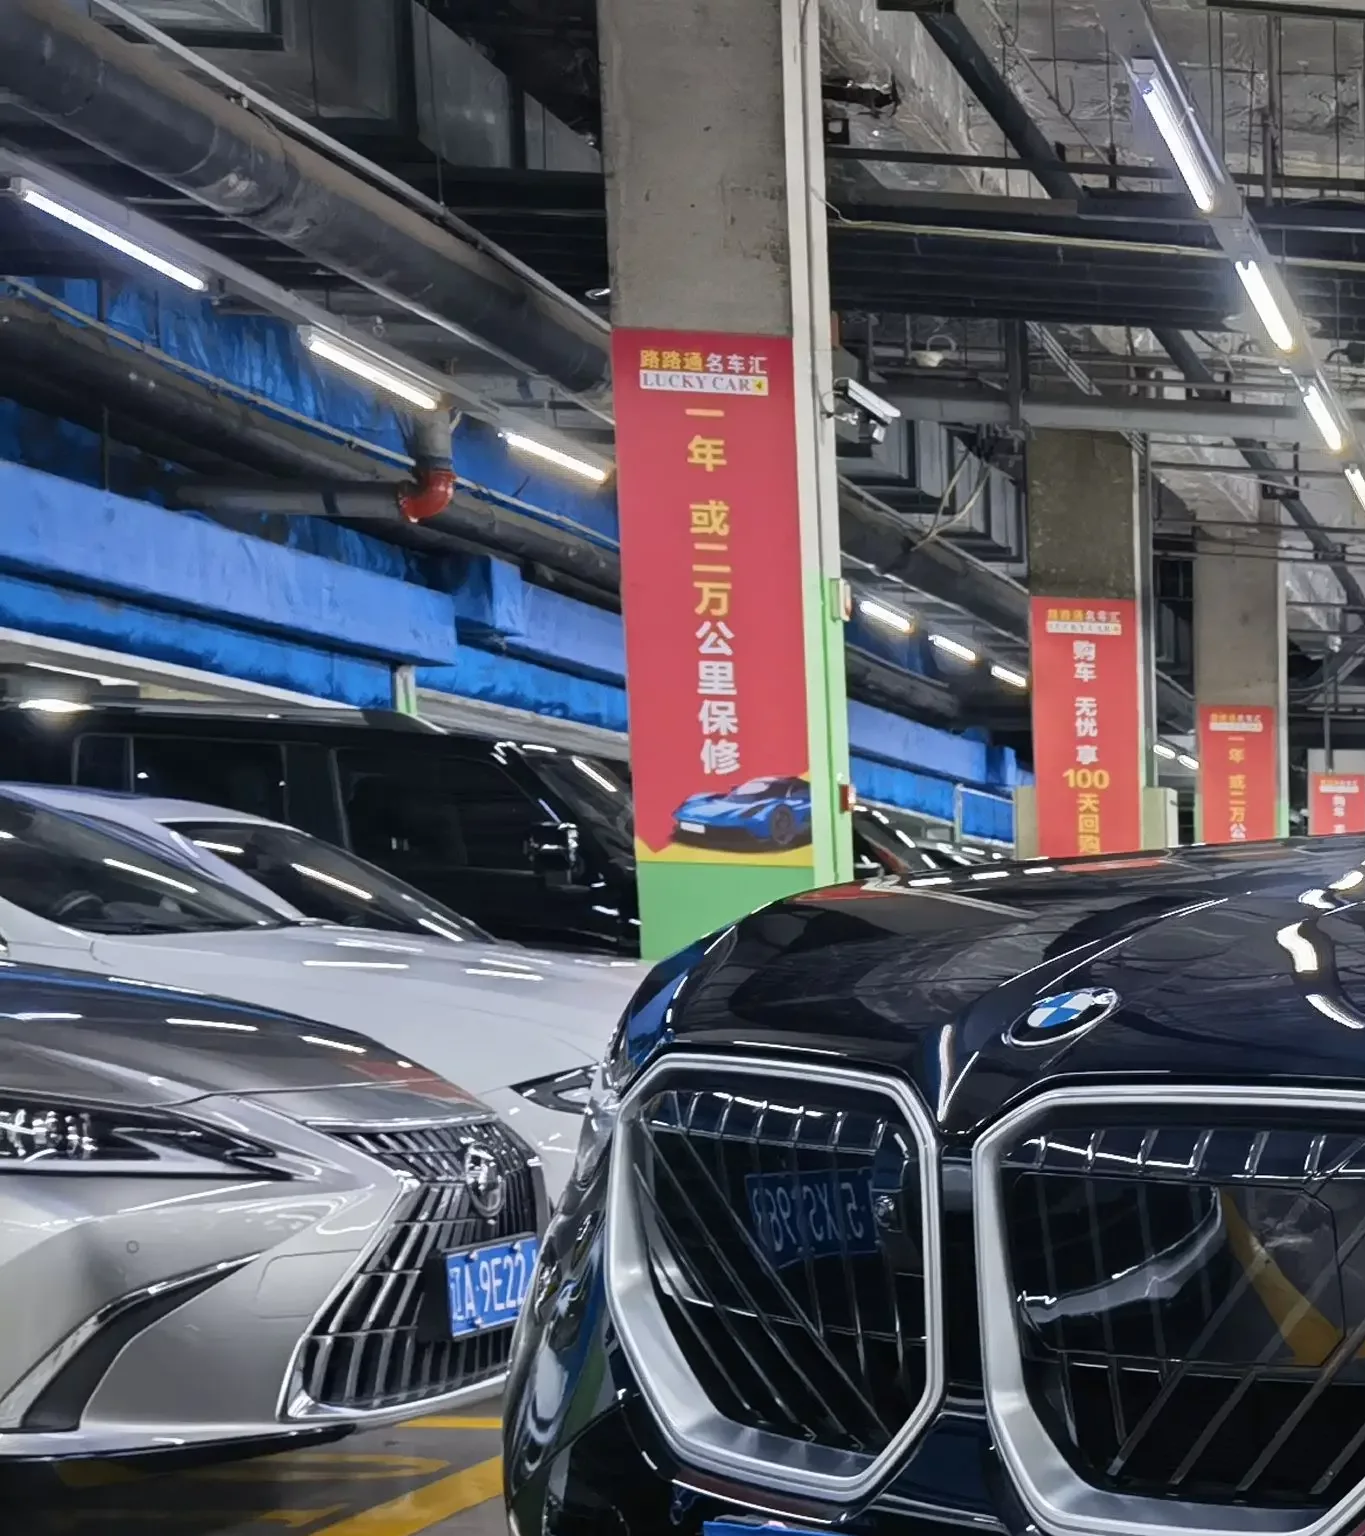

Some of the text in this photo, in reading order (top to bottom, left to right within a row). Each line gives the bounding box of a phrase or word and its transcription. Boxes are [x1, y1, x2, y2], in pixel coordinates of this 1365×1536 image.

[640, 349, 768, 374] 路路通名车汇
[643, 372, 751, 392] LUCKY CAR
